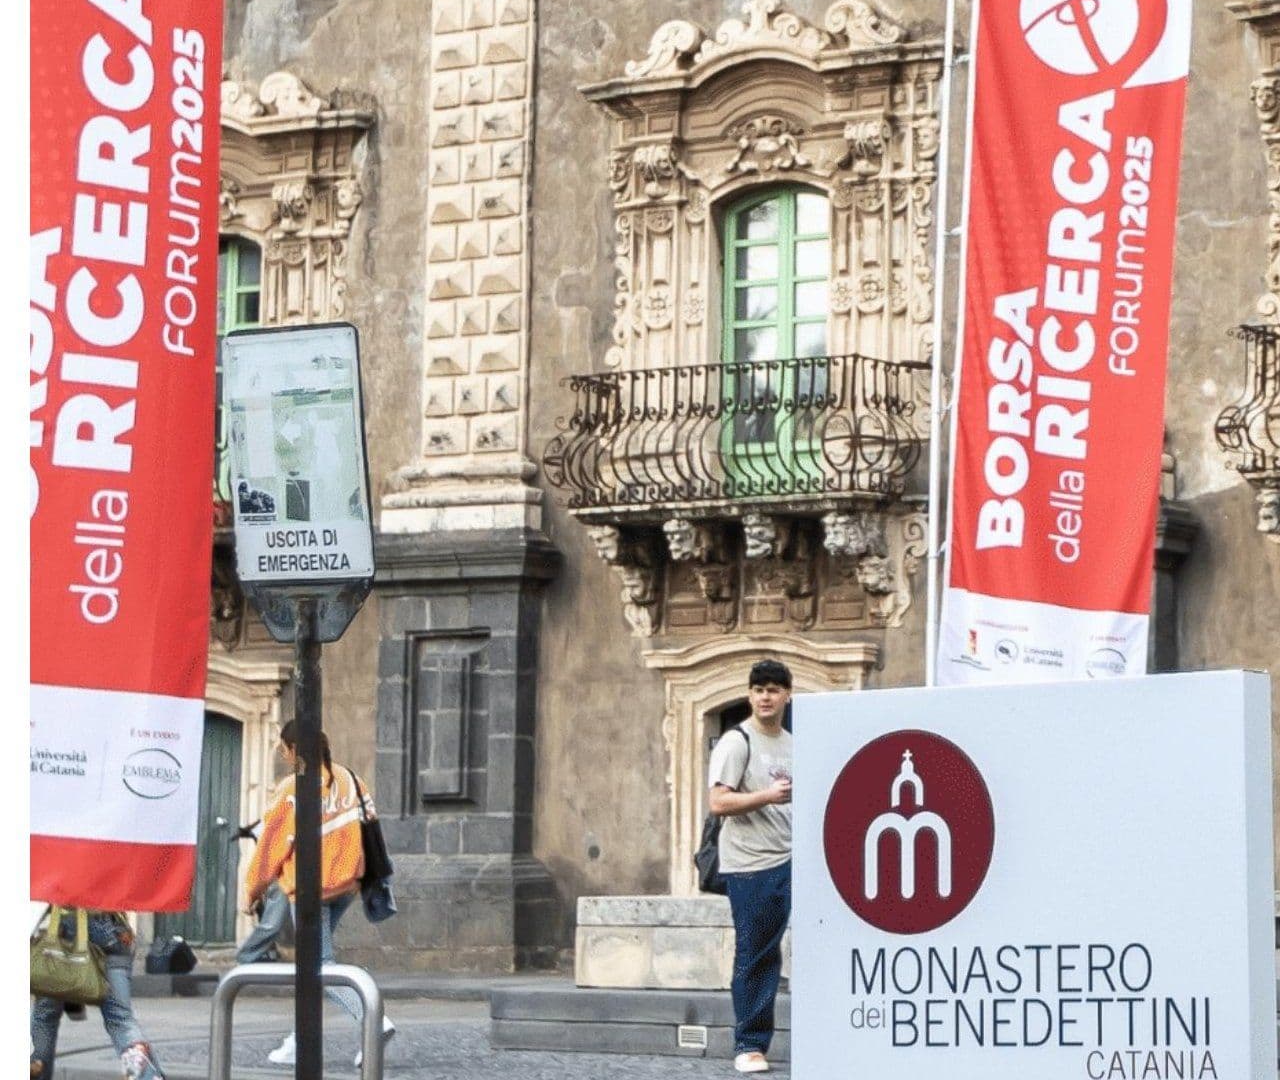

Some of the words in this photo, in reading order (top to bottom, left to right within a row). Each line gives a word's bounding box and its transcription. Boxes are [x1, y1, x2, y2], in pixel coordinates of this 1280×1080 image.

[1034, 88, 1116, 460] RICERCA
[976, 286, 1039, 551] BORSA
[266, 529, 317, 548] USCITA
[323, 528, 337, 547] DI
[1048, 470, 1084, 564] della
[69, 489, 129, 624] della
[258, 554, 350, 572] EMERGENZA
[850, 942, 1153, 995] MONASTERO
[849, 1001, 887, 1029] dei
[891, 996, 1211, 1047] BENEDETTINI
[1086, 1049, 1219, 1080] CATANIA
